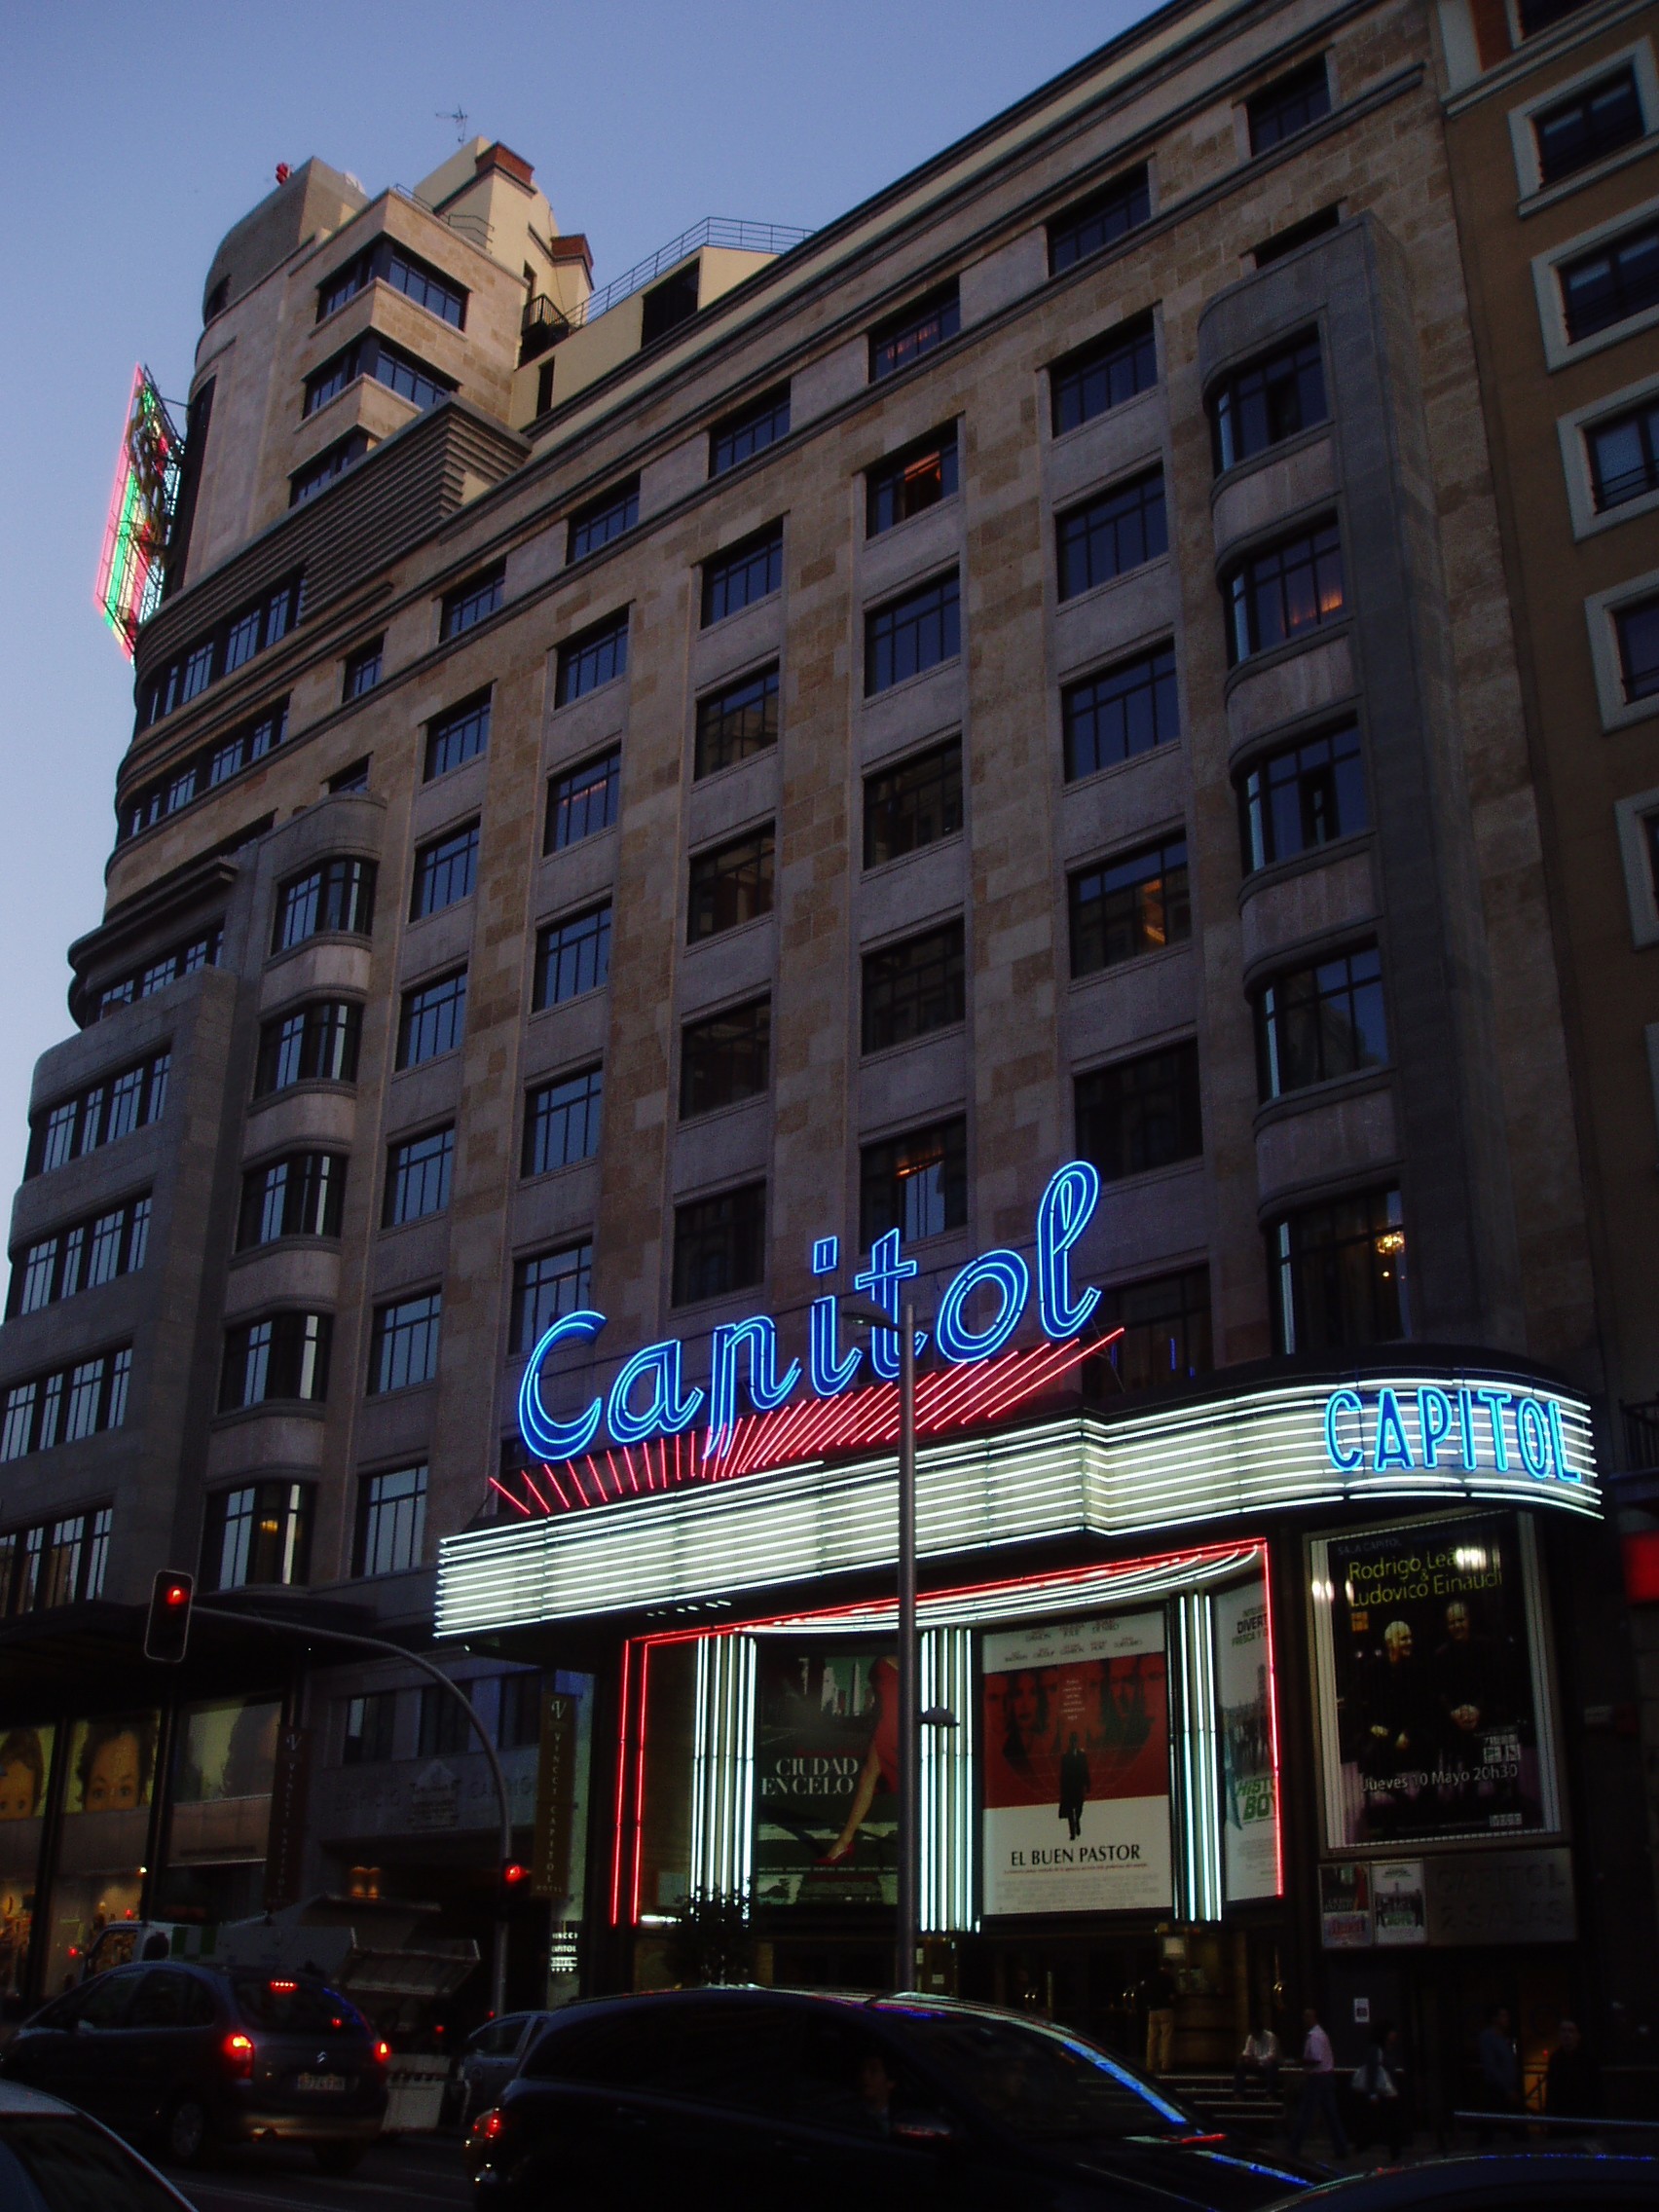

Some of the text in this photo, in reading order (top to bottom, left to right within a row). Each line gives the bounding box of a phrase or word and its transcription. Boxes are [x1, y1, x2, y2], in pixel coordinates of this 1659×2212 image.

[519, 1160, 1102, 1460] Capitol
[1325, 1385, 1582, 1483] CAPITOL
[1348, 1556, 1421, 1581] Rodrigo
[1351, 1569, 1502, 1607] Ludovico Einaudi
[552, 1732, 562, 1795] VINCCI
[776, 1756, 860, 1777] CIUDAD
[1363, 1776, 1408, 1792] Jueves
[1431, 1770, 1470, 1788] Mayo
[1473, 1764, 1519, 1782] 20h30
[760, 1777, 855, 1795] EN CELO
[546, 1806, 558, 1883] CAPITOL
[1011, 1844, 1141, 1866] EL BUEN PASTOR
